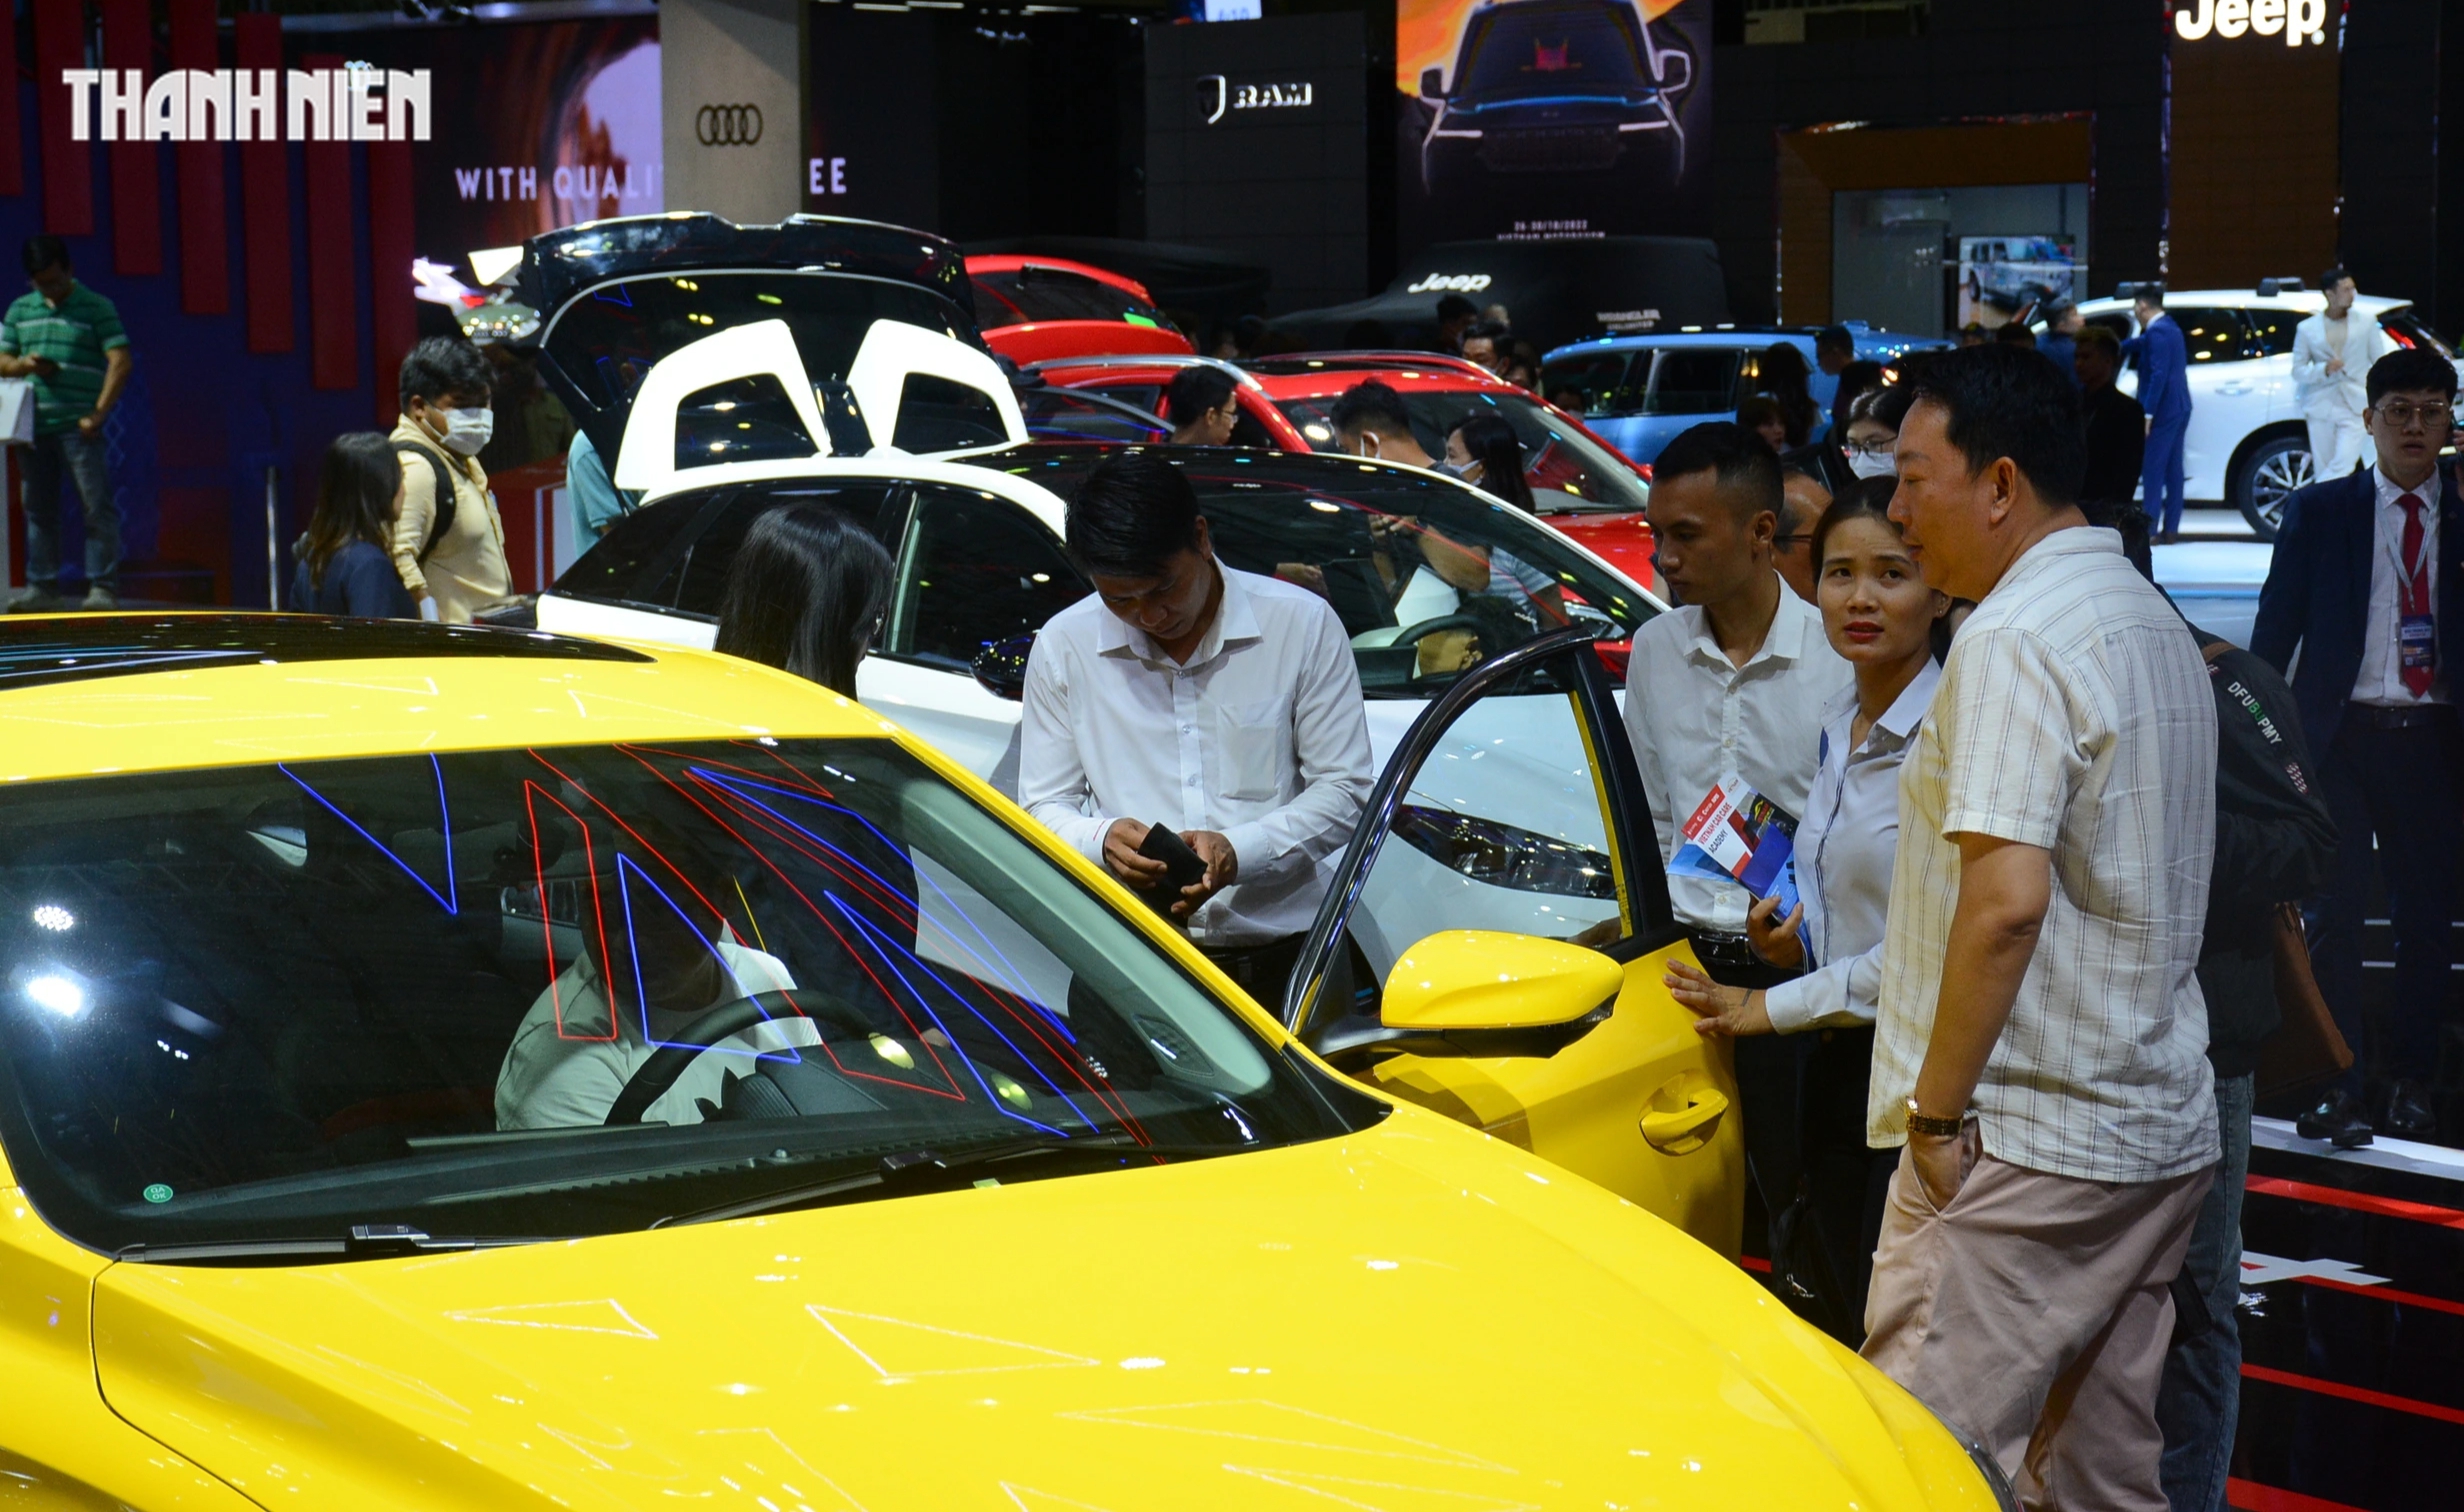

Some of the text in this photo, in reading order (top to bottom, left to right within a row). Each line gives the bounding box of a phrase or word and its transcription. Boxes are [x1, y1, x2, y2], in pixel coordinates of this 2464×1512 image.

[2175, 0, 2326, 47] Jeep
[1233, 81, 1313, 109] RAM
[454, 167, 538, 201] WITH
[553, 164, 663, 199] QUALI
[1407, 272, 1492, 294] Jeep
[2227, 680, 2283, 745] DFUBUPMY
[1711, 812, 1723, 827] CAR
[1719, 801, 1734, 818] CARE
[1707, 828, 1730, 854] ACADEMY
